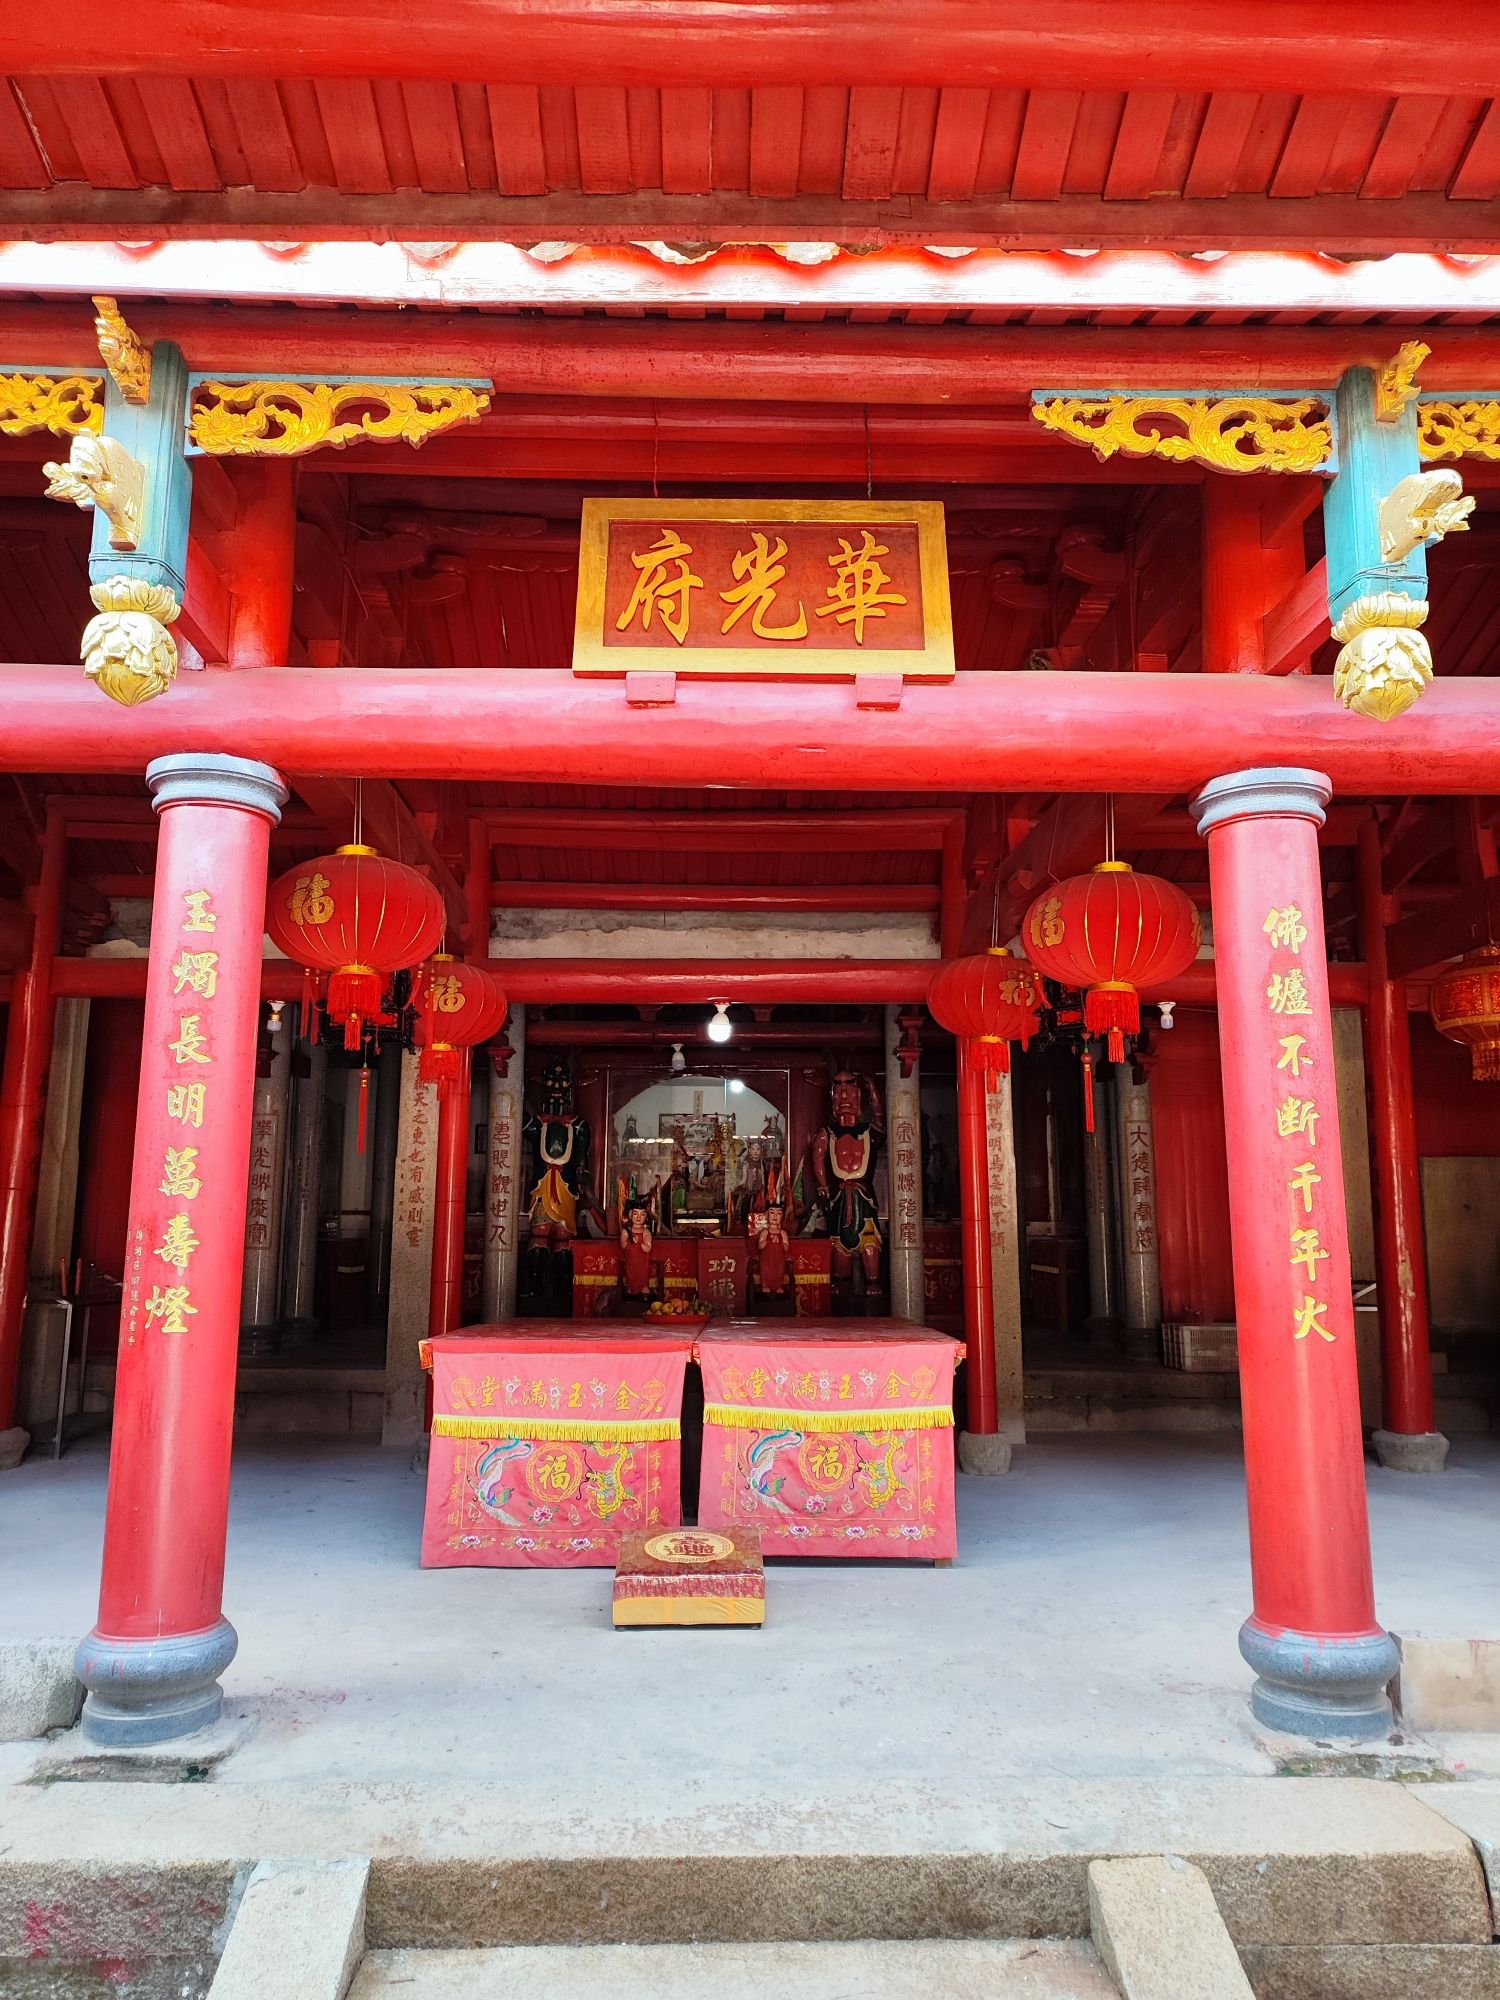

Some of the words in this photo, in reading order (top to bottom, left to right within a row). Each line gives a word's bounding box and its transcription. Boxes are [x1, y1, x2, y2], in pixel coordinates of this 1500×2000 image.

[615, 528, 907, 645] 華光府
[286, 873, 335, 926] 福
[1030, 896, 1066, 949] 福
[708, 1255, 737, 1318] 功德
[537, 1454, 571, 1490] 福
[807, 1444, 844, 1480] 福
